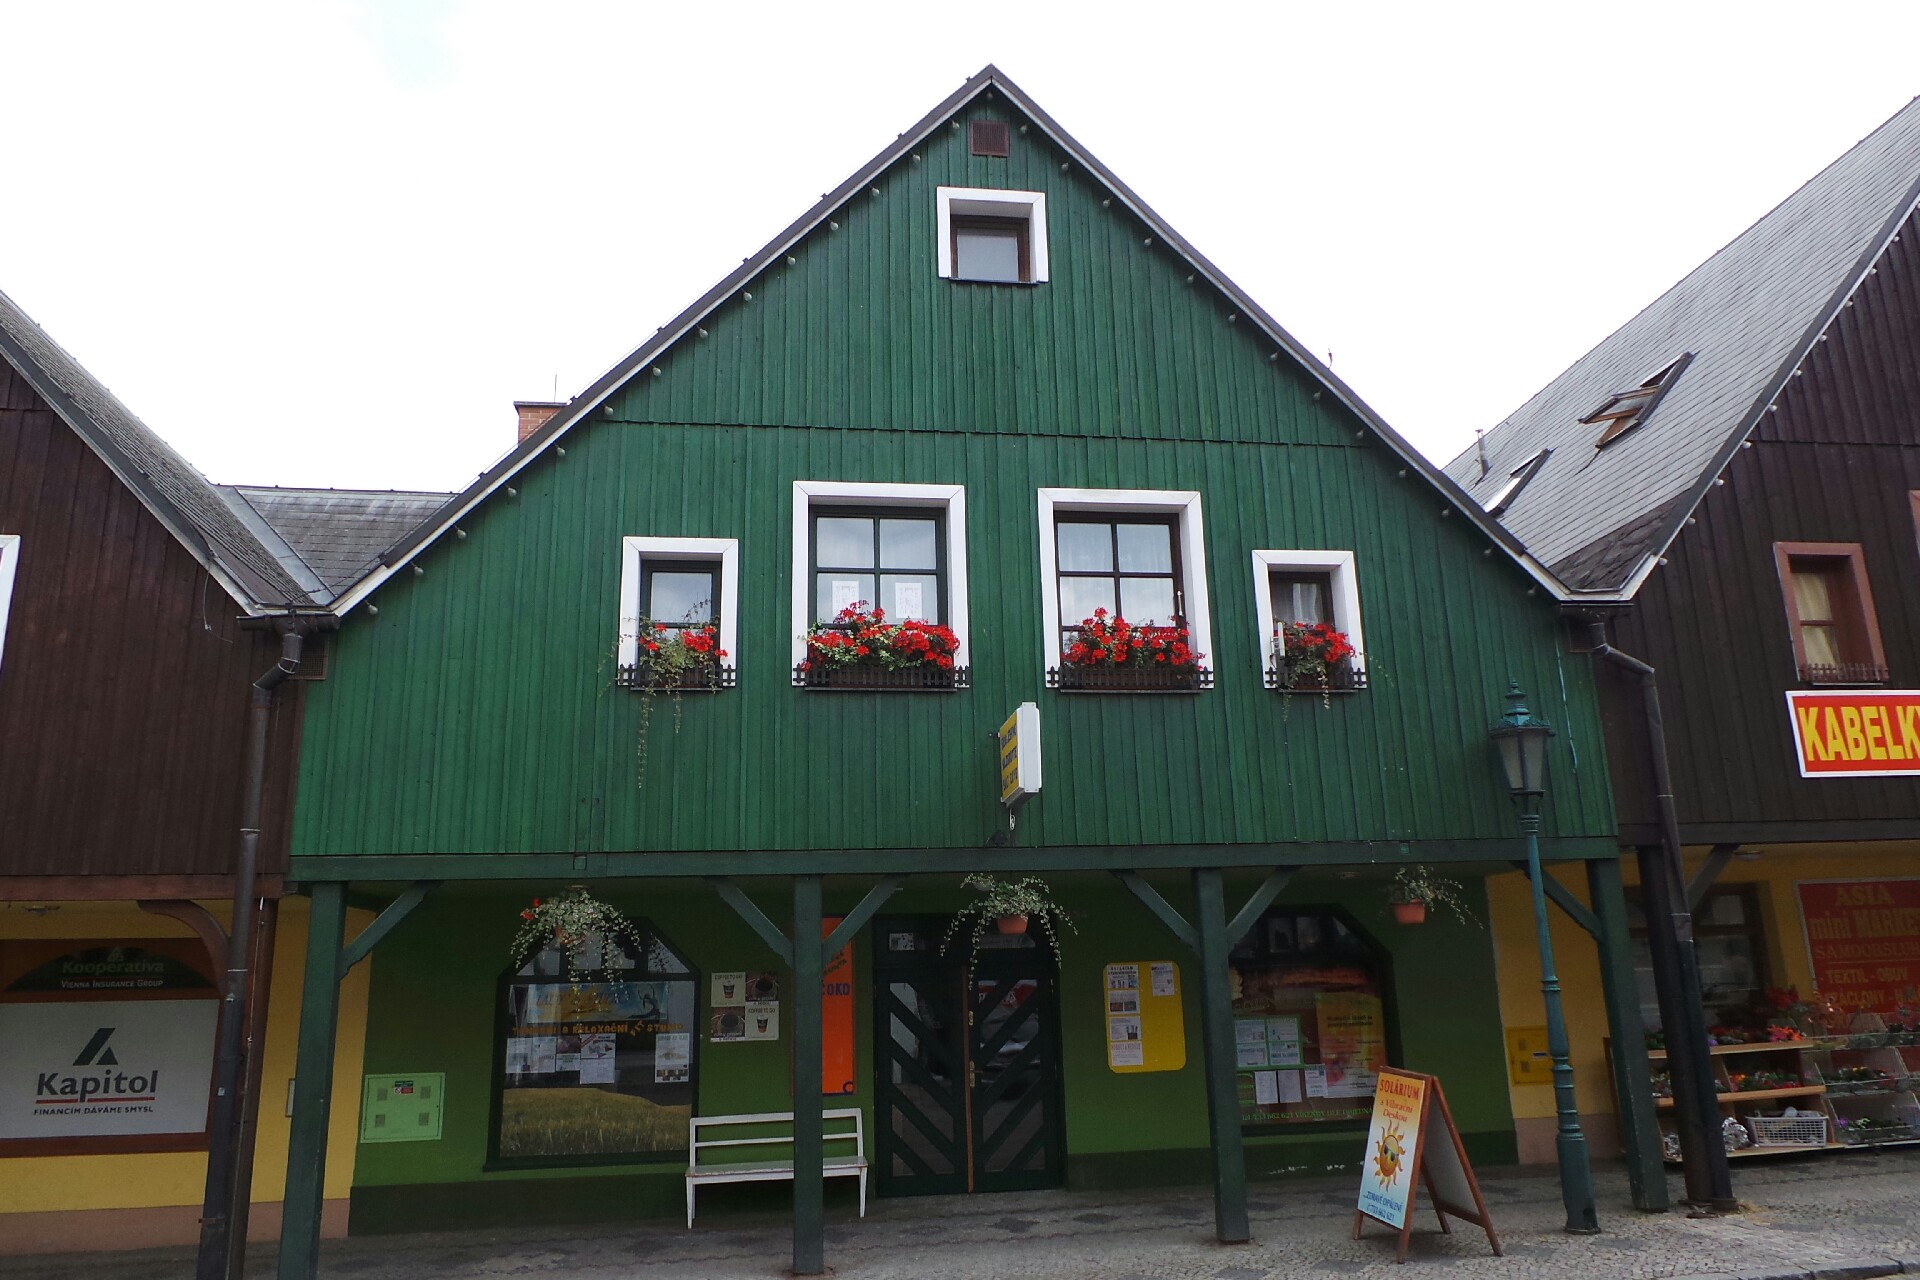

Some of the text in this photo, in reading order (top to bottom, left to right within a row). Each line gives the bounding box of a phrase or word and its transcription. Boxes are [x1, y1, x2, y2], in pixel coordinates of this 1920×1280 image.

[1798, 705, 1920, 760] KABELK
[1835, 885, 1895, 906] ASIA
[1809, 910, 1852, 939] mini
[62, 959, 164, 976] Kooperativa
[1826, 966, 1907, 984] TEXTIL OBUV
[61, 979, 164, 989] VIENNA INSURANCE GROUP
[572, 1022, 628, 1034] RELAXAČNÍ
[36, 1069, 158, 1103] Kapitol
[1380, 1078, 1420, 1100] SOLÁRIUM
[33, 1105, 154, 1115] FINANCÍM DÁVÁME SMYSL
